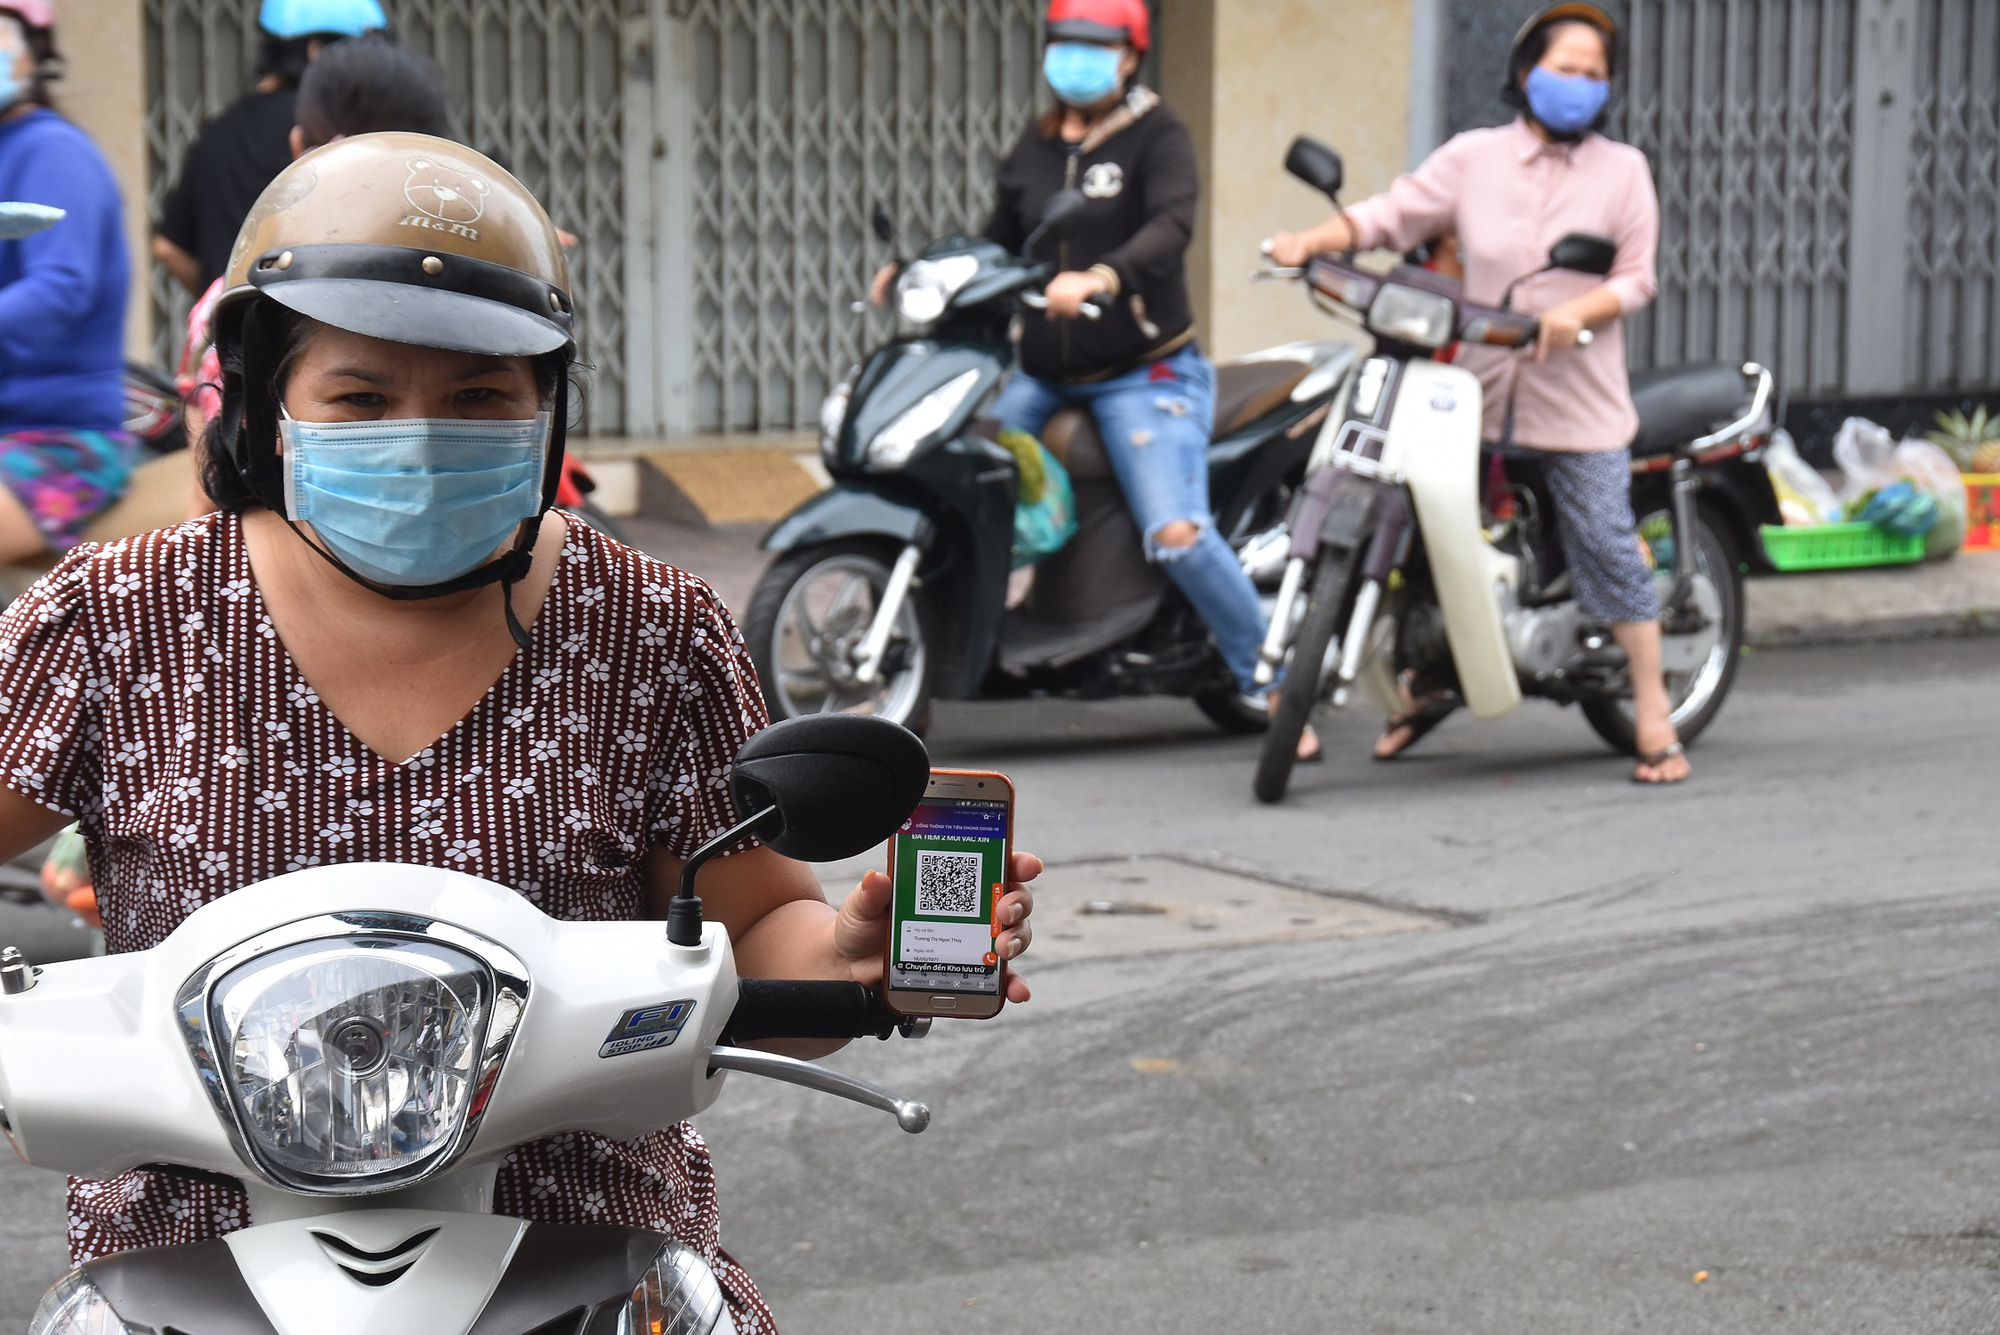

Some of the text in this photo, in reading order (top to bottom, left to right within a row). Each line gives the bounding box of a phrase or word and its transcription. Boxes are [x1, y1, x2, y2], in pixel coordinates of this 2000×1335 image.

[932, 963, 946, 971] đến
[625, 1004, 685, 1029] FI
[610, 1035, 655, 1048] IDLING
[606, 1043, 641, 1054] STOP
